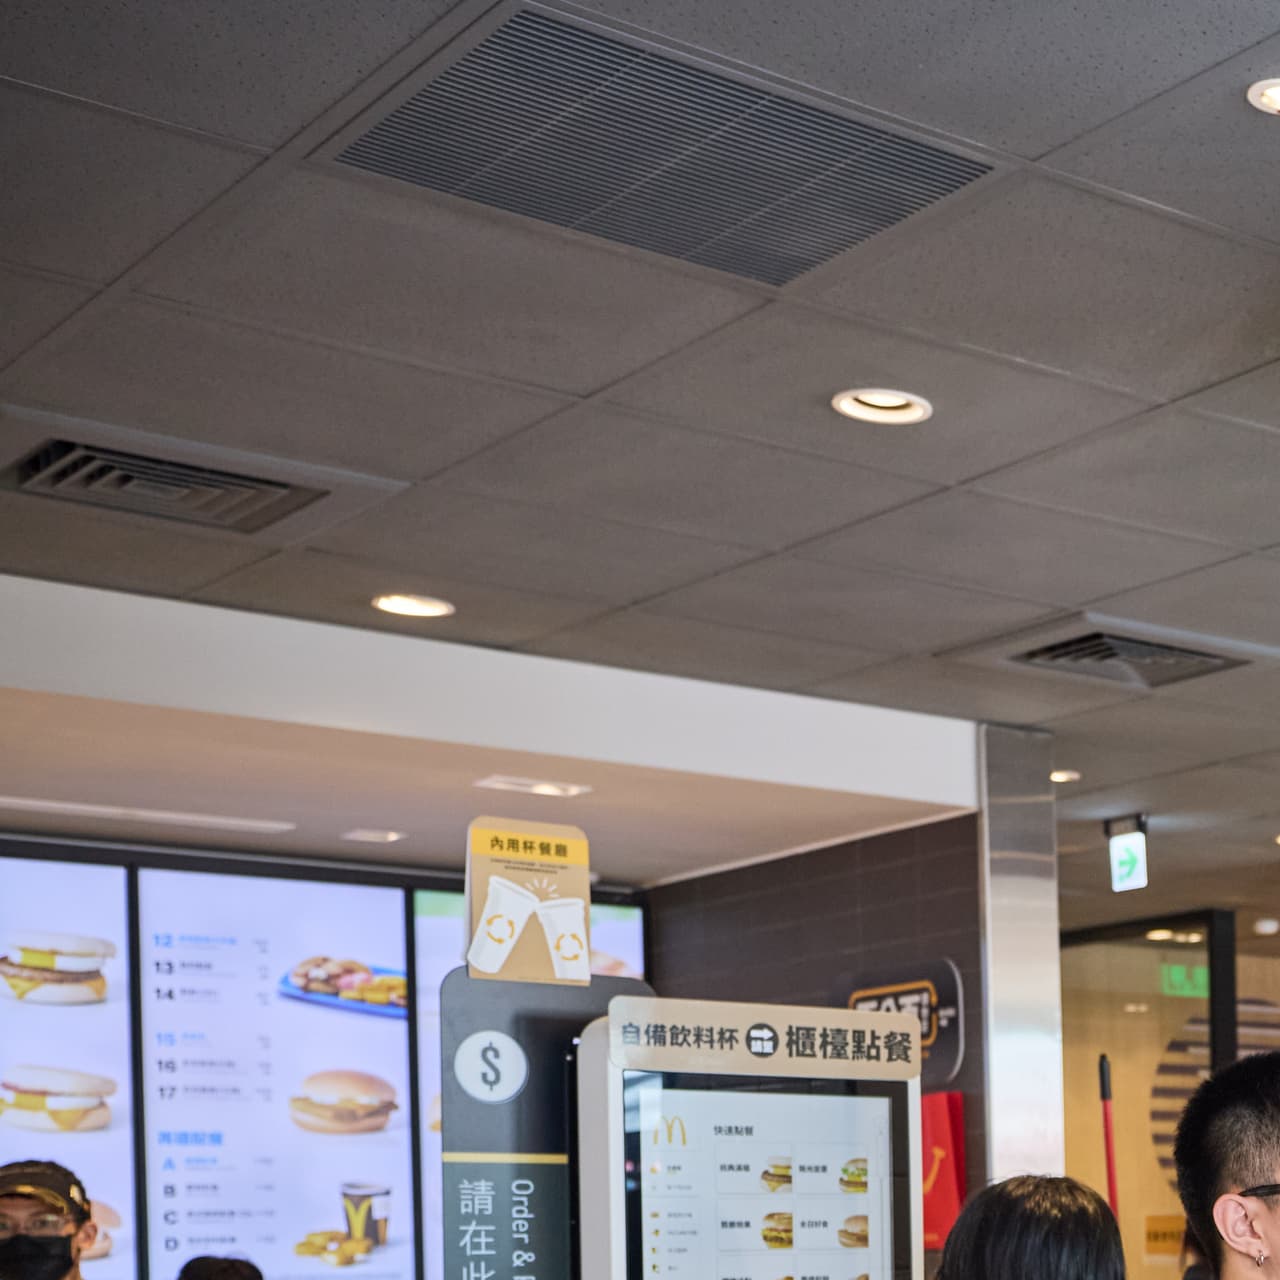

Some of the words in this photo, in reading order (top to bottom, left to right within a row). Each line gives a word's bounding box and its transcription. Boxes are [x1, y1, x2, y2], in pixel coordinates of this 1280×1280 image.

[489, 836, 568, 858] 內用杯餐廳
[621, 1022, 740, 1051] 自備飲料杯
[784, 1023, 913, 1064] 櫃檯點餐
[510, 1179, 536, 1244] Order
[511, 1250, 537, 1267] &
